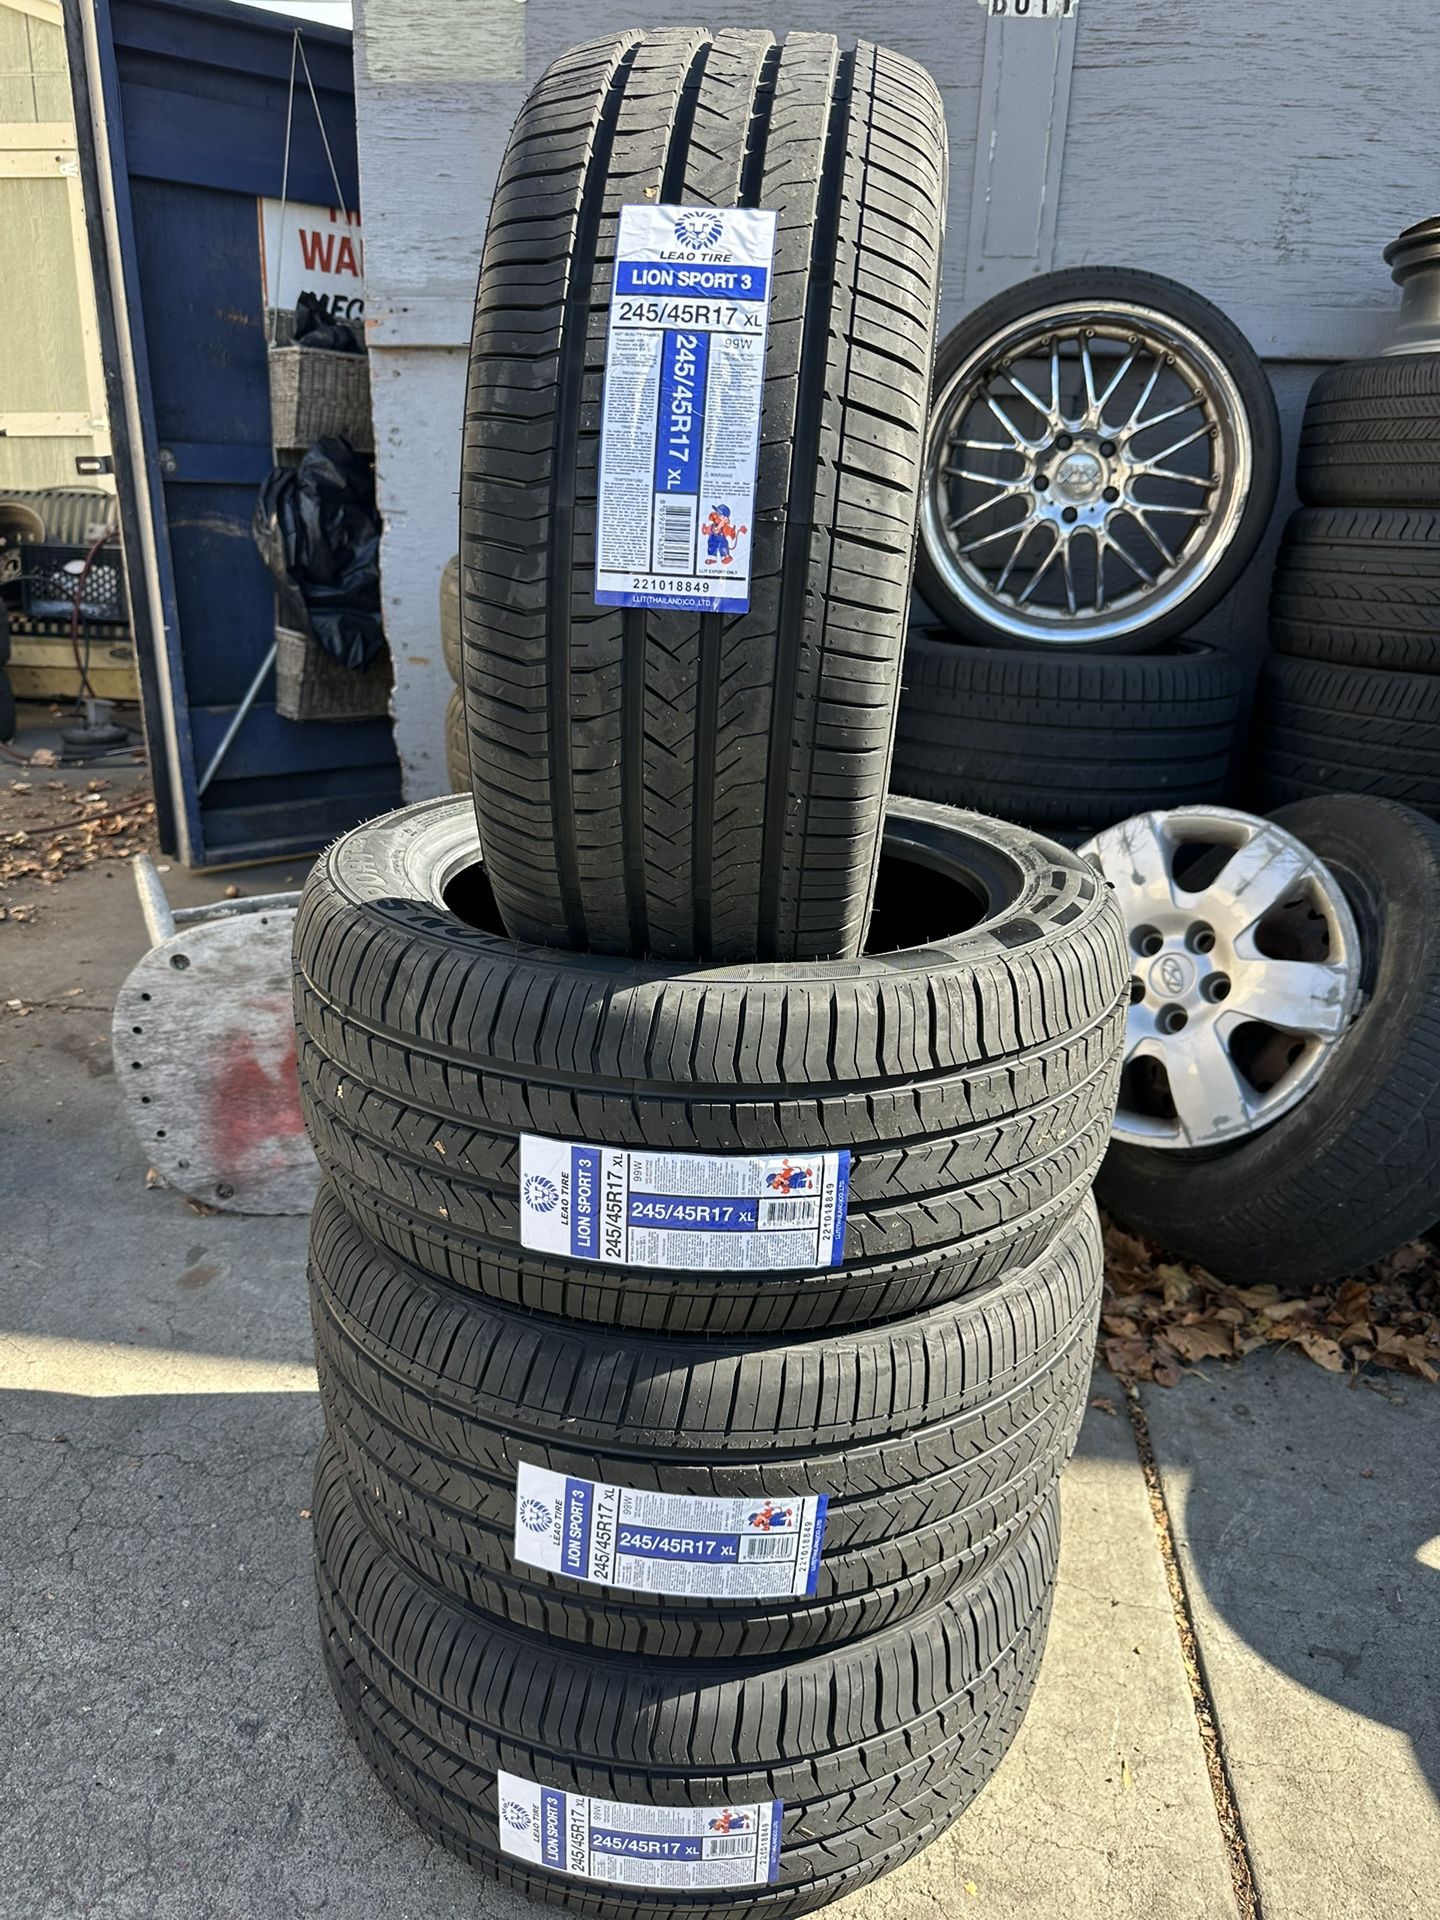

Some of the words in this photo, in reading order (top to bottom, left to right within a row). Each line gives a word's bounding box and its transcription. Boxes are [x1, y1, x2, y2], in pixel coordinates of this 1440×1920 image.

[298, 229, 363, 278] WA
[659, 251, 695, 261] LEAO
[701, 253, 733, 263] TIRE
[632, 269, 673, 285] LION
[677, 271, 738, 289] SPORT
[740, 274, 752, 290] 3
[619, 302, 738, 325] 245/45R17
[743, 314, 762, 327] XL
[725, 338, 753, 350] 99W
[669, 334, 698, 463] 245/45R17
[667, 467, 682, 490] XL
[632, 578, 710, 592] 221018849
[578, 1159, 592, 1168] 3
[612, 1153, 623, 1168] XL
[633, 1160, 642, 1182] 99W
[561, 1172, 569, 1197] TIRE
[577, 1169, 592, 1214] SPORT
[560, 1198, 569, 1226] LEAO
[605, 1171, 623, 1258] 245/45R17
[631, 1202, 734, 1222] 245/45R17
[739, 1211, 755, 1222] XL
[822, 1183, 835, 1240] 221018849
[577, 1216, 591, 1247] LION
[572, 1489, 584, 1499] 3
[623, 1495, 632, 1515] 99W
[554, 1499, 563, 1521] TIRE
[569, 1499, 583, 1539] SPORT
[553, 1523, 562, 1546] LEAO
[593, 1503, 613, 1580] 245/45R17
[603, 1488, 615, 1501] XL
[620, 1532, 716, 1555] 245/45R17
[721, 1545, 736, 1556] XL
[568, 1538, 581, 1568] LION
[799, 1521, 812, 1572] 221018849
[532, 1803, 540, 1822] TIRE
[576, 1797, 585, 1808] XL
[532, 1822, 540, 1843] LEAO
[546, 1804, 558, 1838] SPORT
[547, 1837, 559, 1861] LION
[571, 1809, 584, 1872] 245/45R17
[592, 1834, 680, 1854] 245/45R17
[685, 1846, 699, 1855] XL
[760, 1823, 769, 1865] 221018849
